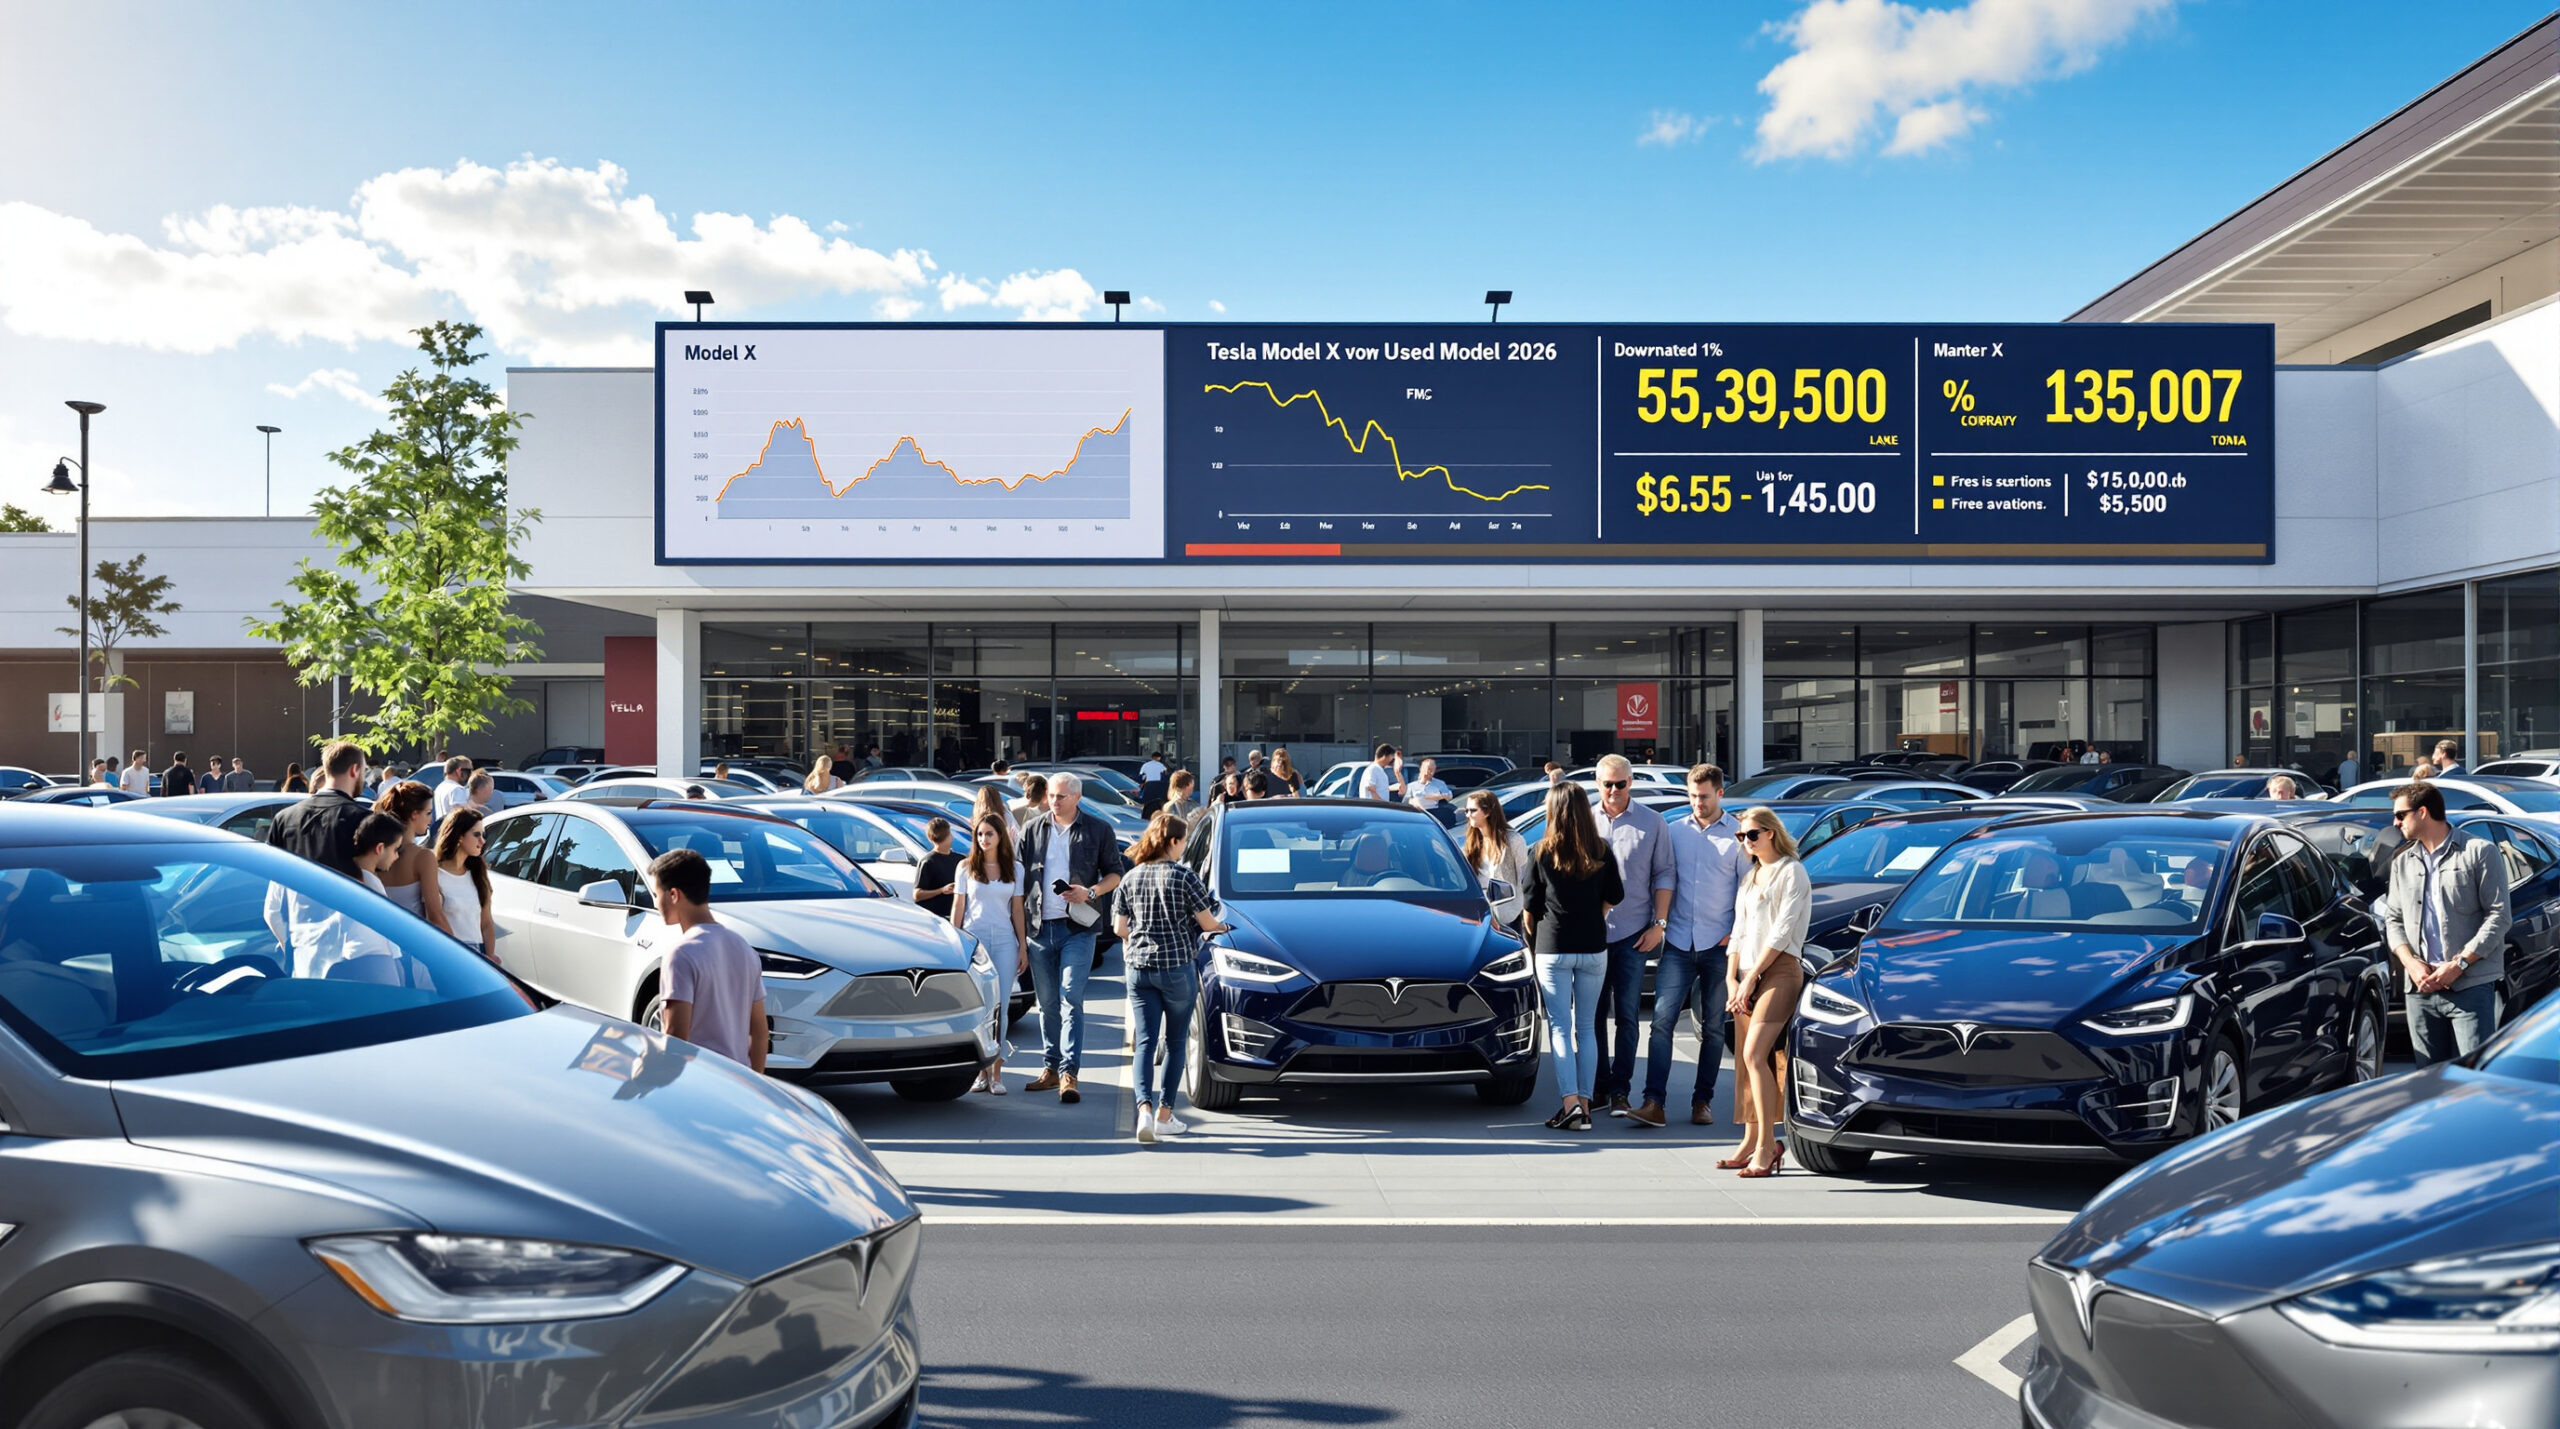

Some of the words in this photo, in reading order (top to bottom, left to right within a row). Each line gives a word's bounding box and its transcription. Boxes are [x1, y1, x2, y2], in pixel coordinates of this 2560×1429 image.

[685, 344, 739, 361] Model
[743, 344, 757, 361] X
[1206, 342, 1257, 361] Tesla
[1262, 342, 1321, 361] Model
[1325, 342, 1341, 361] X
[1384, 342, 1435, 361] Used
[1440, 341, 1501, 361] Model
[1507, 341, 1558, 361] 2026
[1701, 342, 1724, 357] 1%
[1933, 342, 1988, 358] Manter
[1991, 342, 2004, 358] X
[1637, 368, 1887, 430] 55,39,500
[1943, 379, 1975, 413] %
[2046, 368, 2243, 431] 135,007
[1951, 475, 1980, 488] Fres
[1981, 475, 1993, 488] is
[1636, 471, 1732, 517] $6.55
[1761, 481, 1876, 517] 1,45.00
[1986, 497, 2047, 510] avations.
[2099, 492, 2167, 516] $5,500
